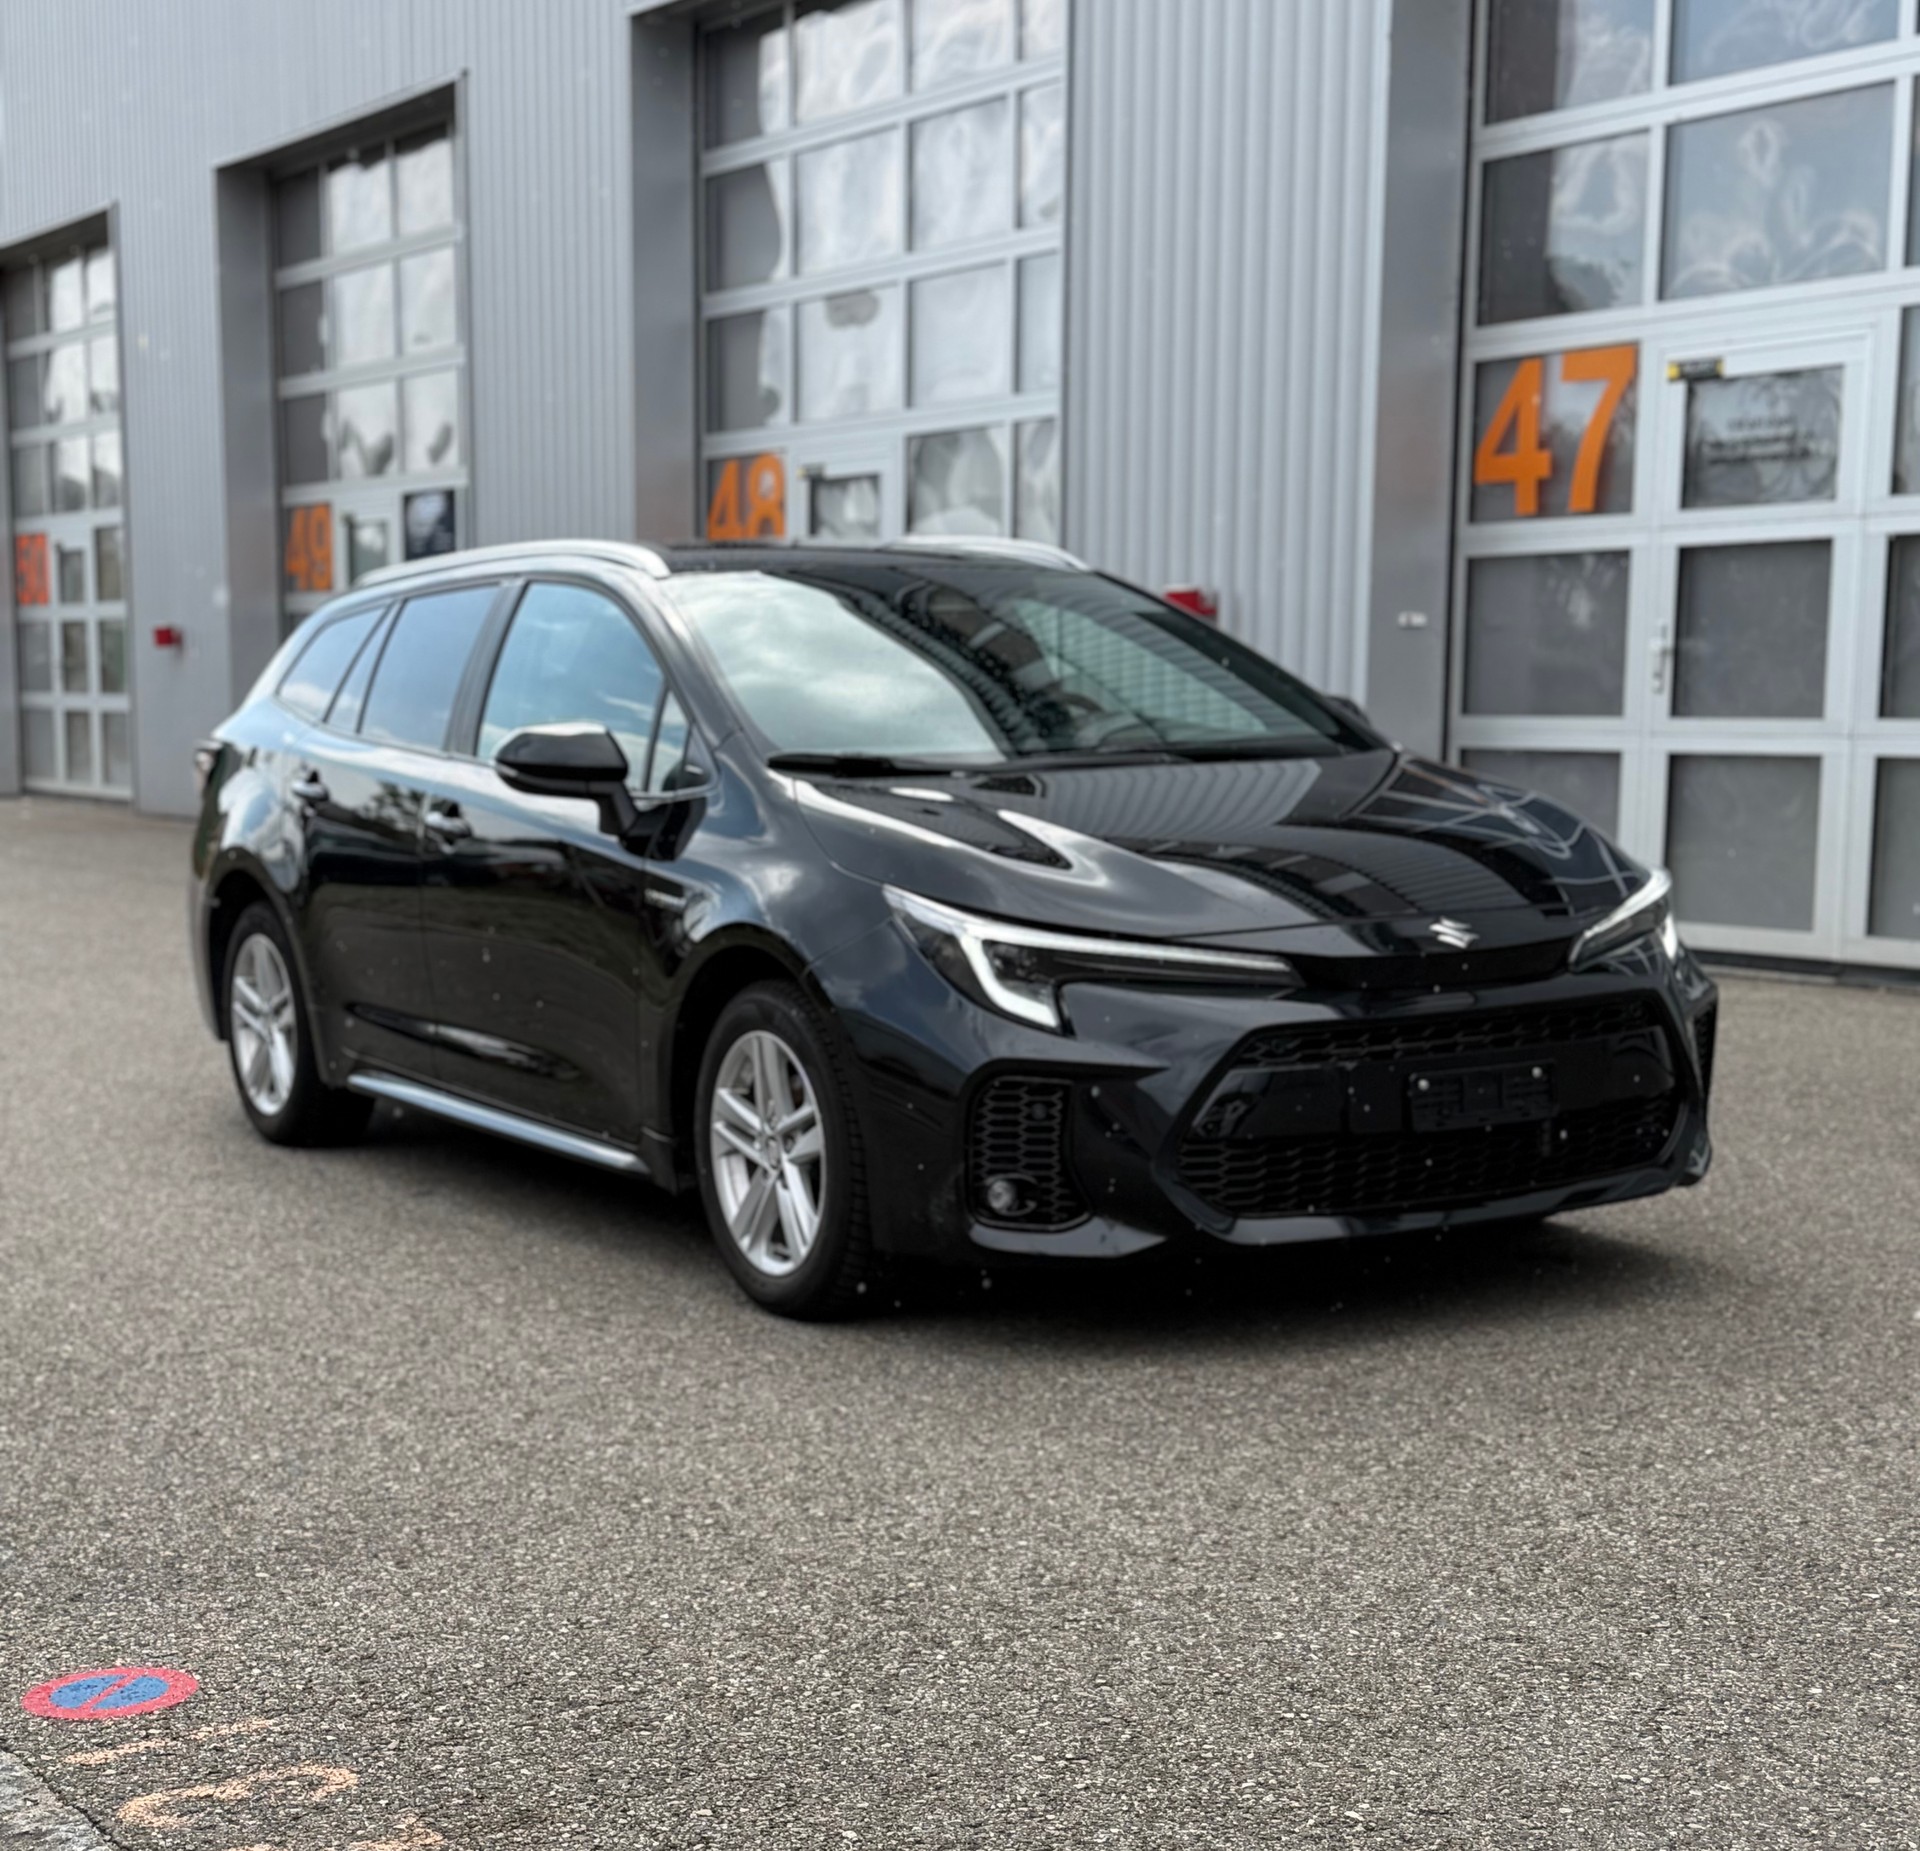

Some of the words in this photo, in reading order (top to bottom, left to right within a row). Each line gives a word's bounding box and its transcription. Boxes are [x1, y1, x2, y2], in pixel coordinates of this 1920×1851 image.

[1474, 343, 1638, 516] 47
[708, 450, 785, 541] 48
[286, 503, 332, 591] 49
